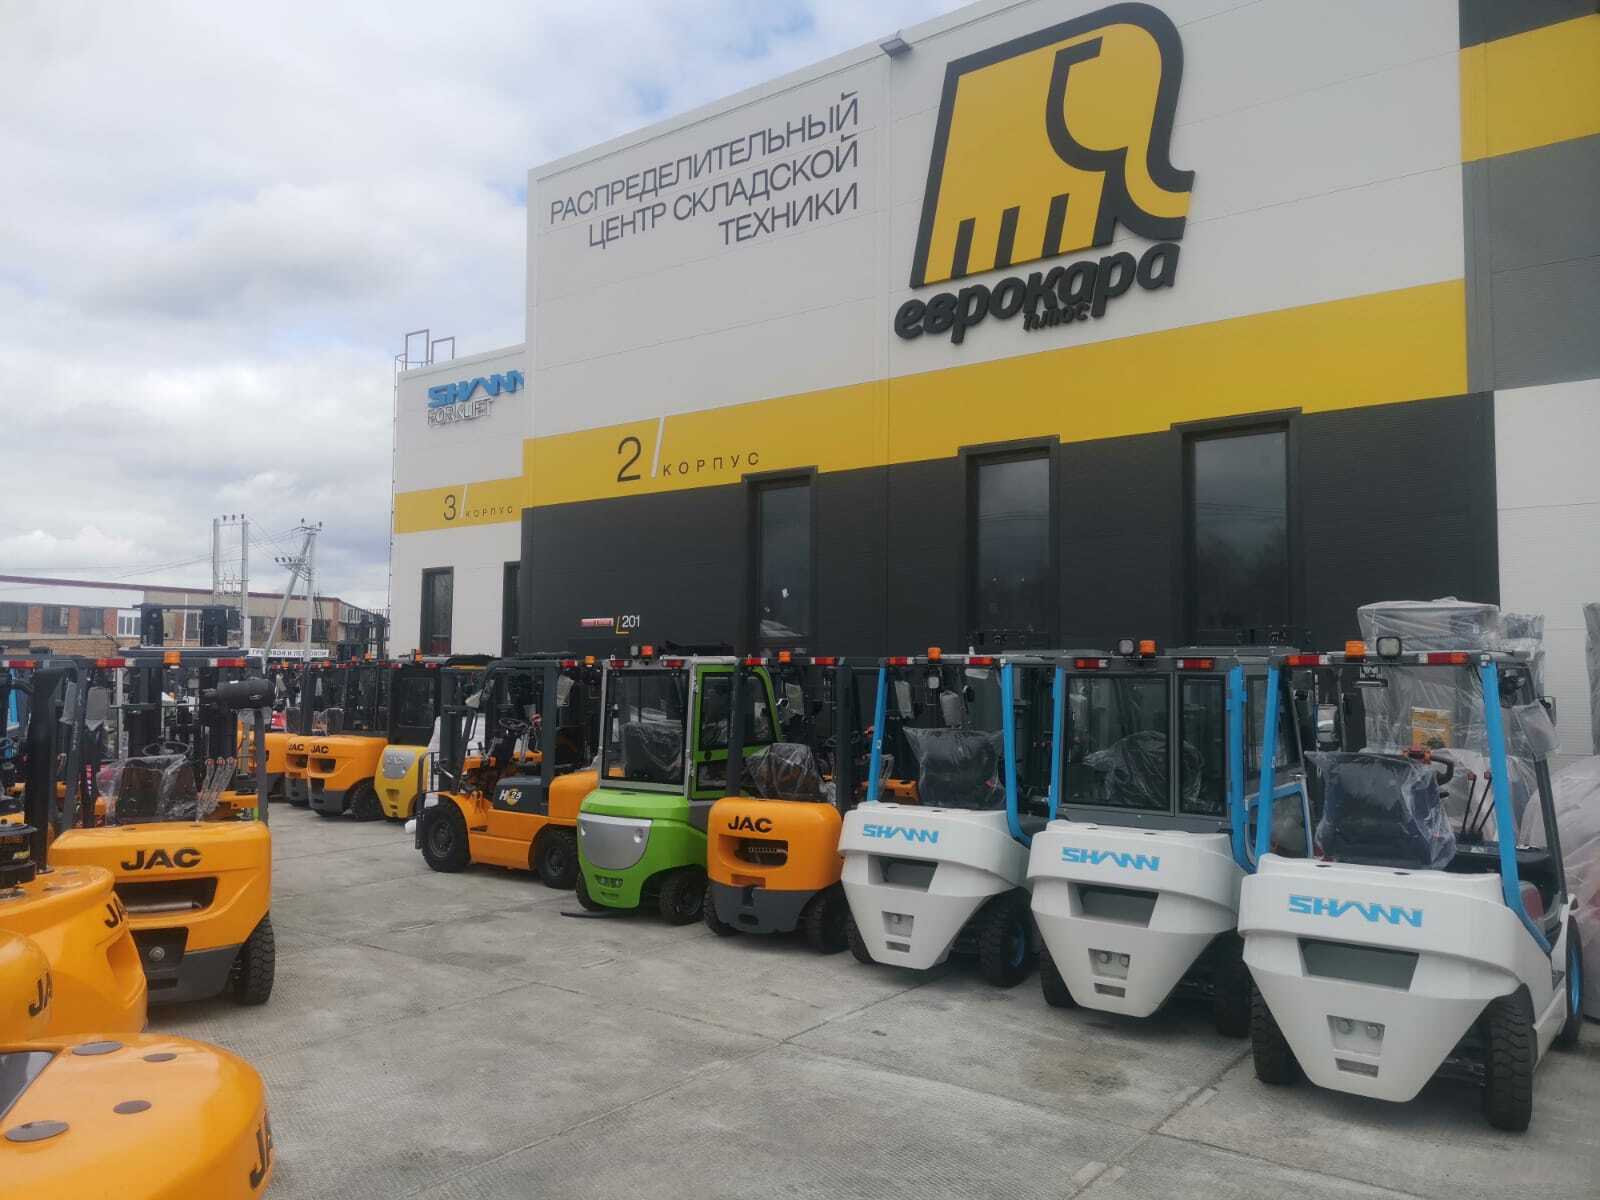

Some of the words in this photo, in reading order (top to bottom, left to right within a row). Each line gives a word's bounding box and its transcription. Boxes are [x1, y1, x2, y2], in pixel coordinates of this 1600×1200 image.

[550, 90, 859, 225] РАСПРЕДЕЛИТЕЛЬНЫЙ
[588, 202, 667, 249] ЦЕНТР
[673, 133, 859, 221] СКЛАДСКОЙ
[718, 182, 859, 246] ТЕХНИКИ
[894, 242, 1181, 345] еврокара
[427, 397, 495, 426] FORKLIFT
[616, 436, 642, 483] 2
[663, 451, 760, 477] КОРПУС
[443, 494, 457, 521] 3
[621, 615, 641, 628] 201
[311, 744, 329, 754] JAC
[728, 816, 773, 833] JAC
[863, 823, 940, 844] SHANN
[120, 847, 201, 871] JAC
[1061, 847, 1160, 871] SHANN
[1288, 894, 1424, 928] SHANN
